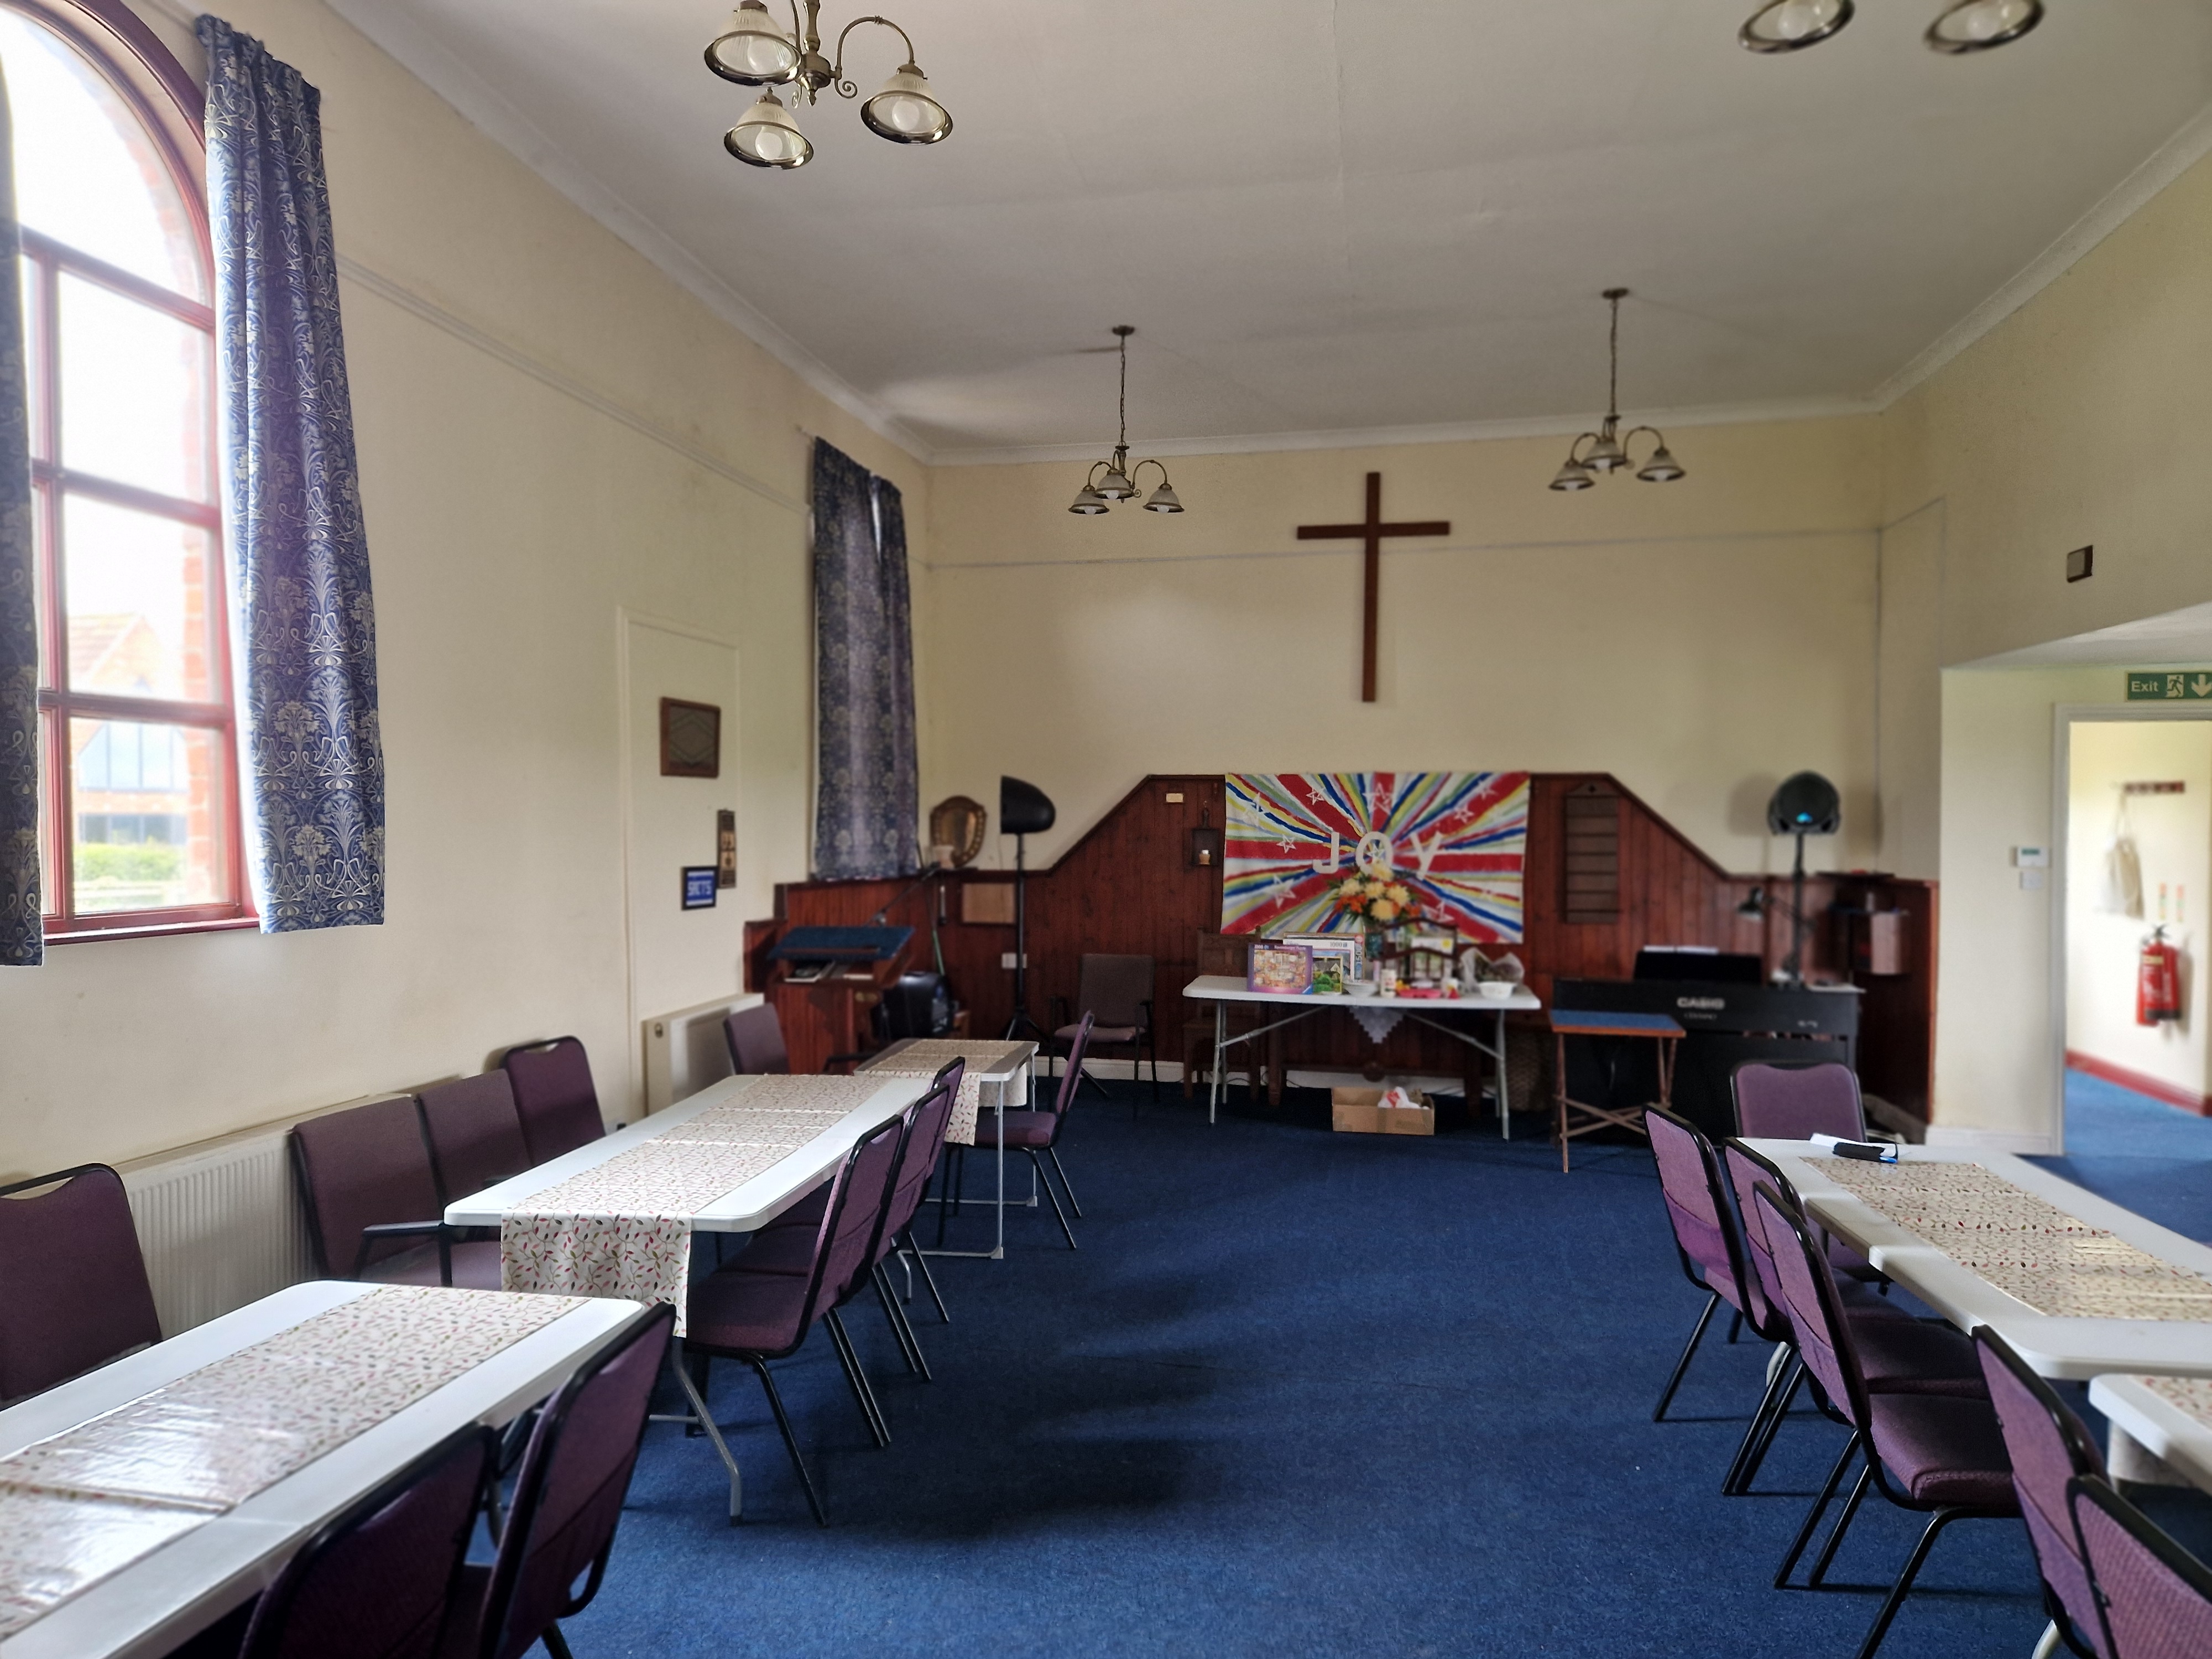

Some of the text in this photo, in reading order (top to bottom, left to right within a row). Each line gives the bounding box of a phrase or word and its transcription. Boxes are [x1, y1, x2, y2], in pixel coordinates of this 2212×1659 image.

[2131, 681, 2158, 692] Exit
[1313, 831, 1442, 880] JOY
[1677, 997, 1724, 1009] CASIO
